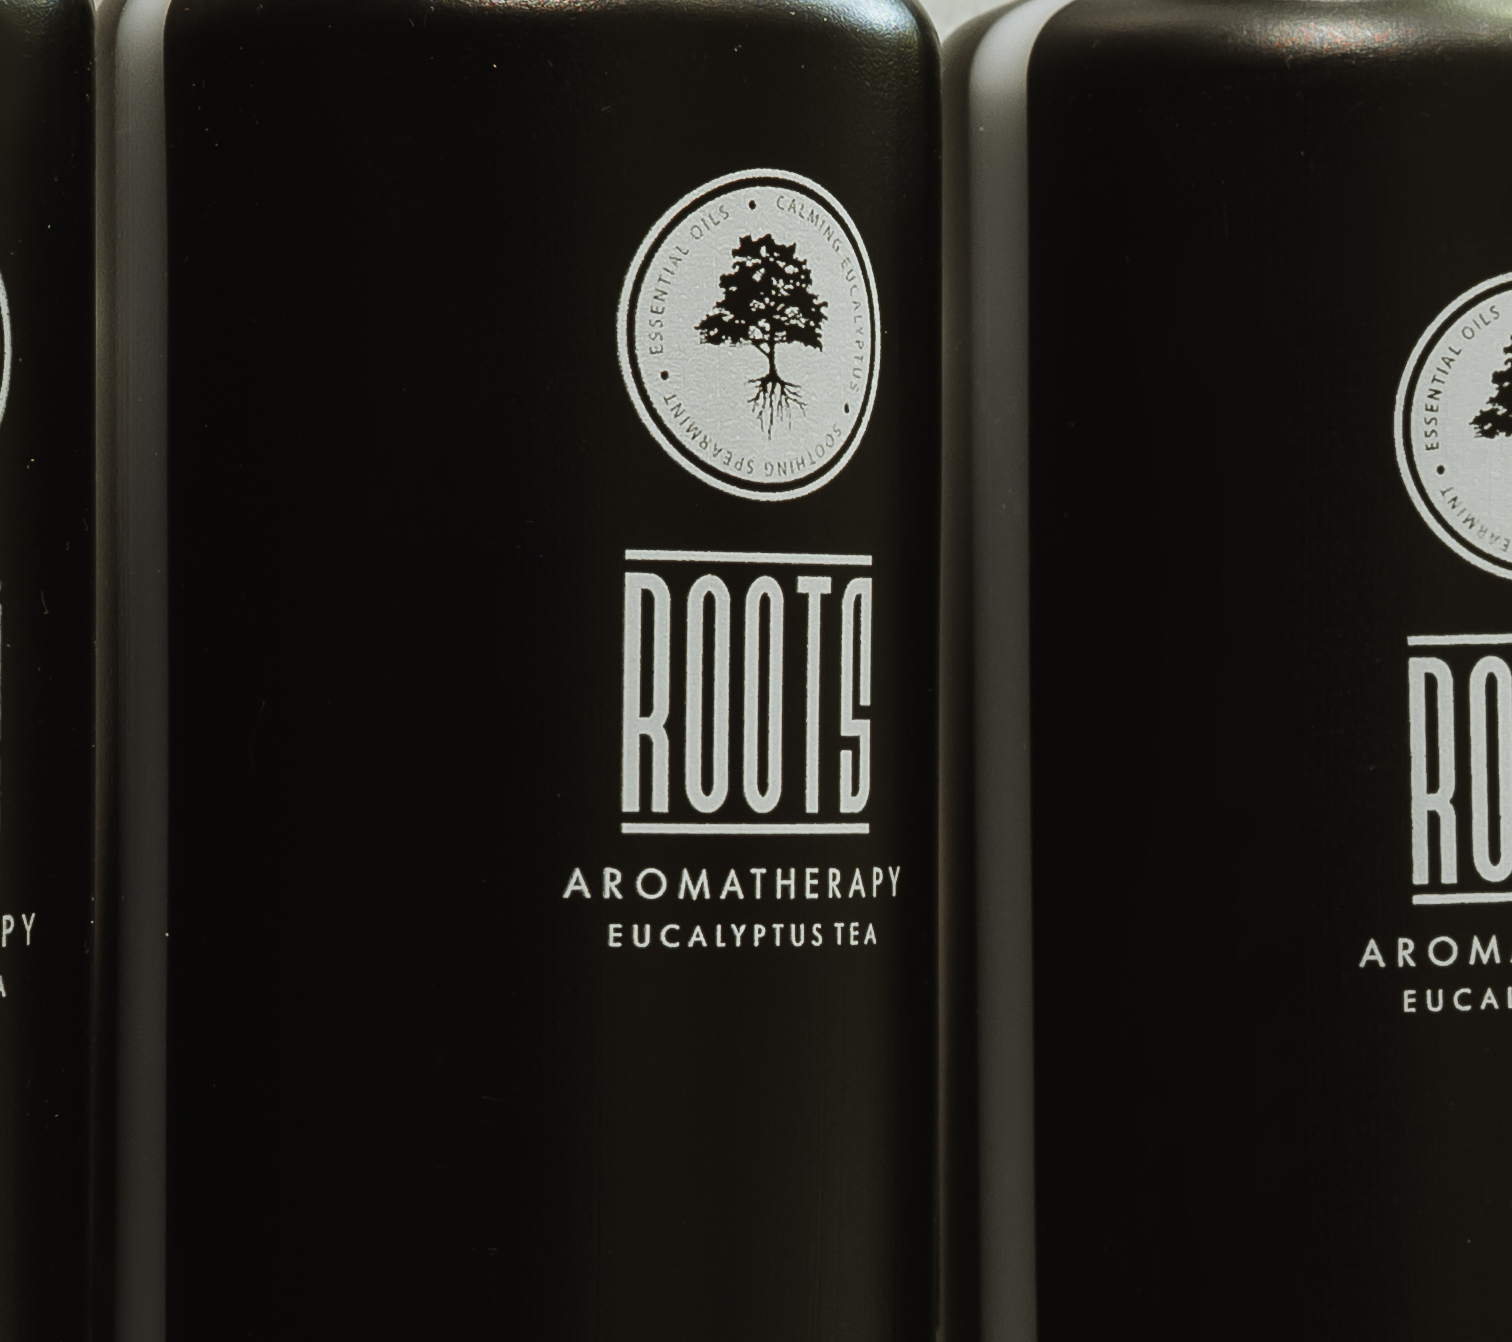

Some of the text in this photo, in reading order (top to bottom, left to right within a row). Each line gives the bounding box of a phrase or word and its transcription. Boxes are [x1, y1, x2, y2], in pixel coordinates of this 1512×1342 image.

[649, 204, 730, 355] ESSENTIAL OILS
[775, 195, 865, 393] CALMING EUCALYPTUS
[663, 393, 843, 477] SOOTHING SPEARMINT
[1424, 305, 1501, 451] ESSENTIAL OILS
[621, 572, 872, 813] ROOTS
[563, 866, 900, 900] AROMATHERAPY
[608, 922, 876, 948] EUCALYPTUS TEA
